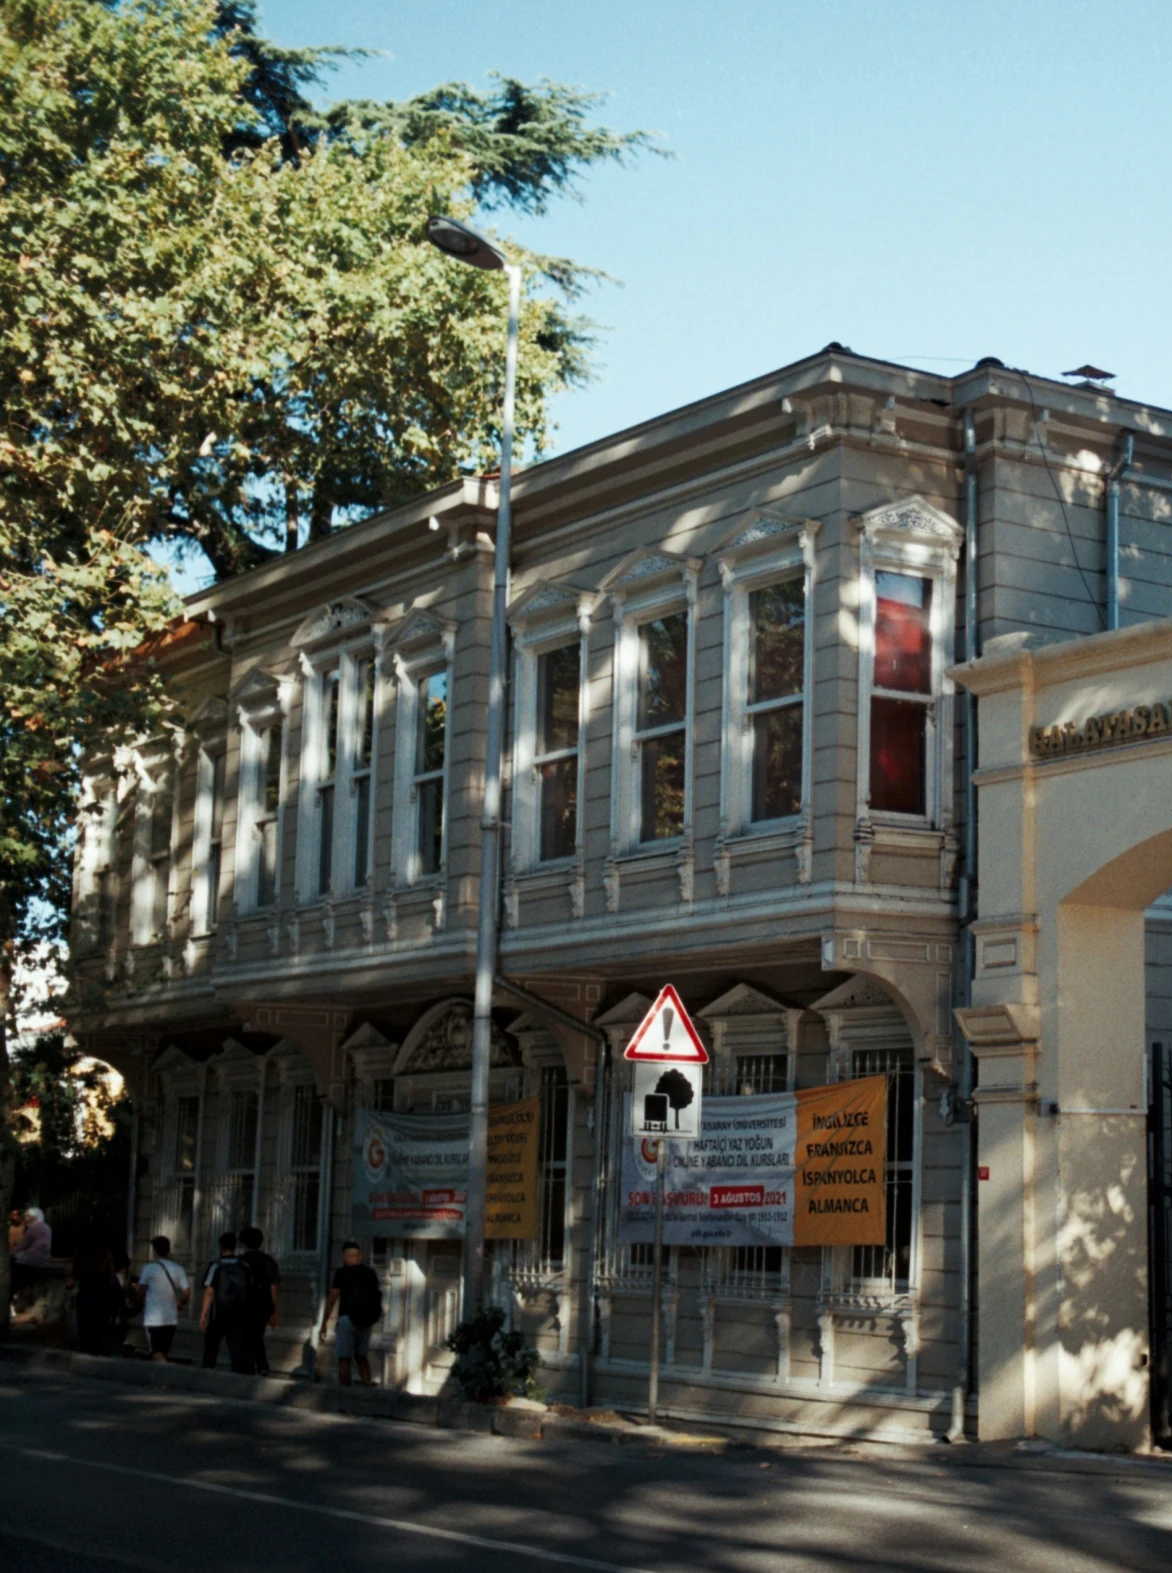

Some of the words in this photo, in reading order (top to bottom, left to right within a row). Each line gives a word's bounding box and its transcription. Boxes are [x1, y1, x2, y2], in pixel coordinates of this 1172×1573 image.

[812, 1111, 869, 1130] İNGİLİZCE
[729, 1137, 743, 1150] YAZ
[744, 1134, 774, 1151] YOĞUN
[806, 1140, 873, 1157] FRANSIZCA
[751, 1152, 790, 1167] KURSLARI
[802, 1168, 877, 1187] İSPANYOLCA
[627, 1191, 650, 1207] SON
[712, 1193, 719, 1205] 3
[721, 1190, 761, 1204] AĞUSTOS
[763, 1191, 787, 1206] 2021
[808, 1197, 869, 1214] ALMANCA
